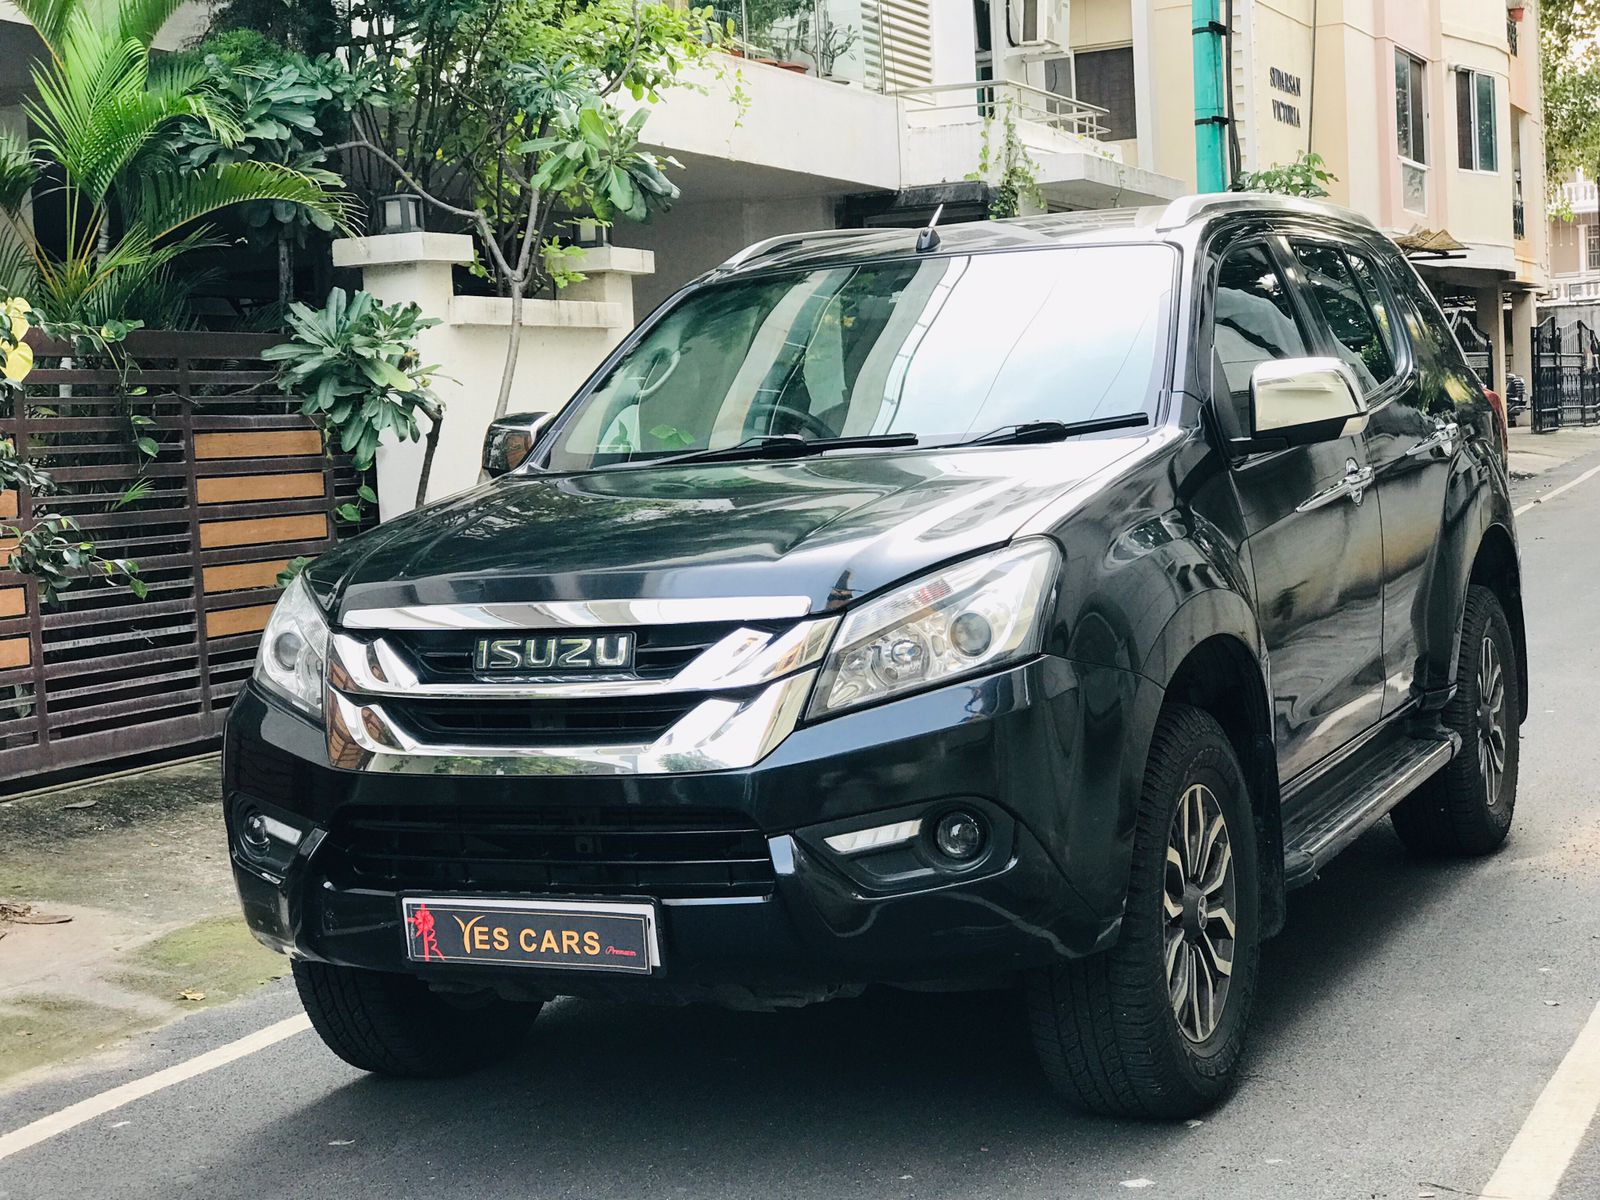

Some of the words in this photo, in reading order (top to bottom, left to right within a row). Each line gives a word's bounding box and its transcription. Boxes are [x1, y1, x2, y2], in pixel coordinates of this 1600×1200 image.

[1272, 98, 1301, 128] VICTORIA
[475, 636, 628, 669] ISUZU
[452, 914, 510, 954] YES
[518, 927, 602, 956] CARS
